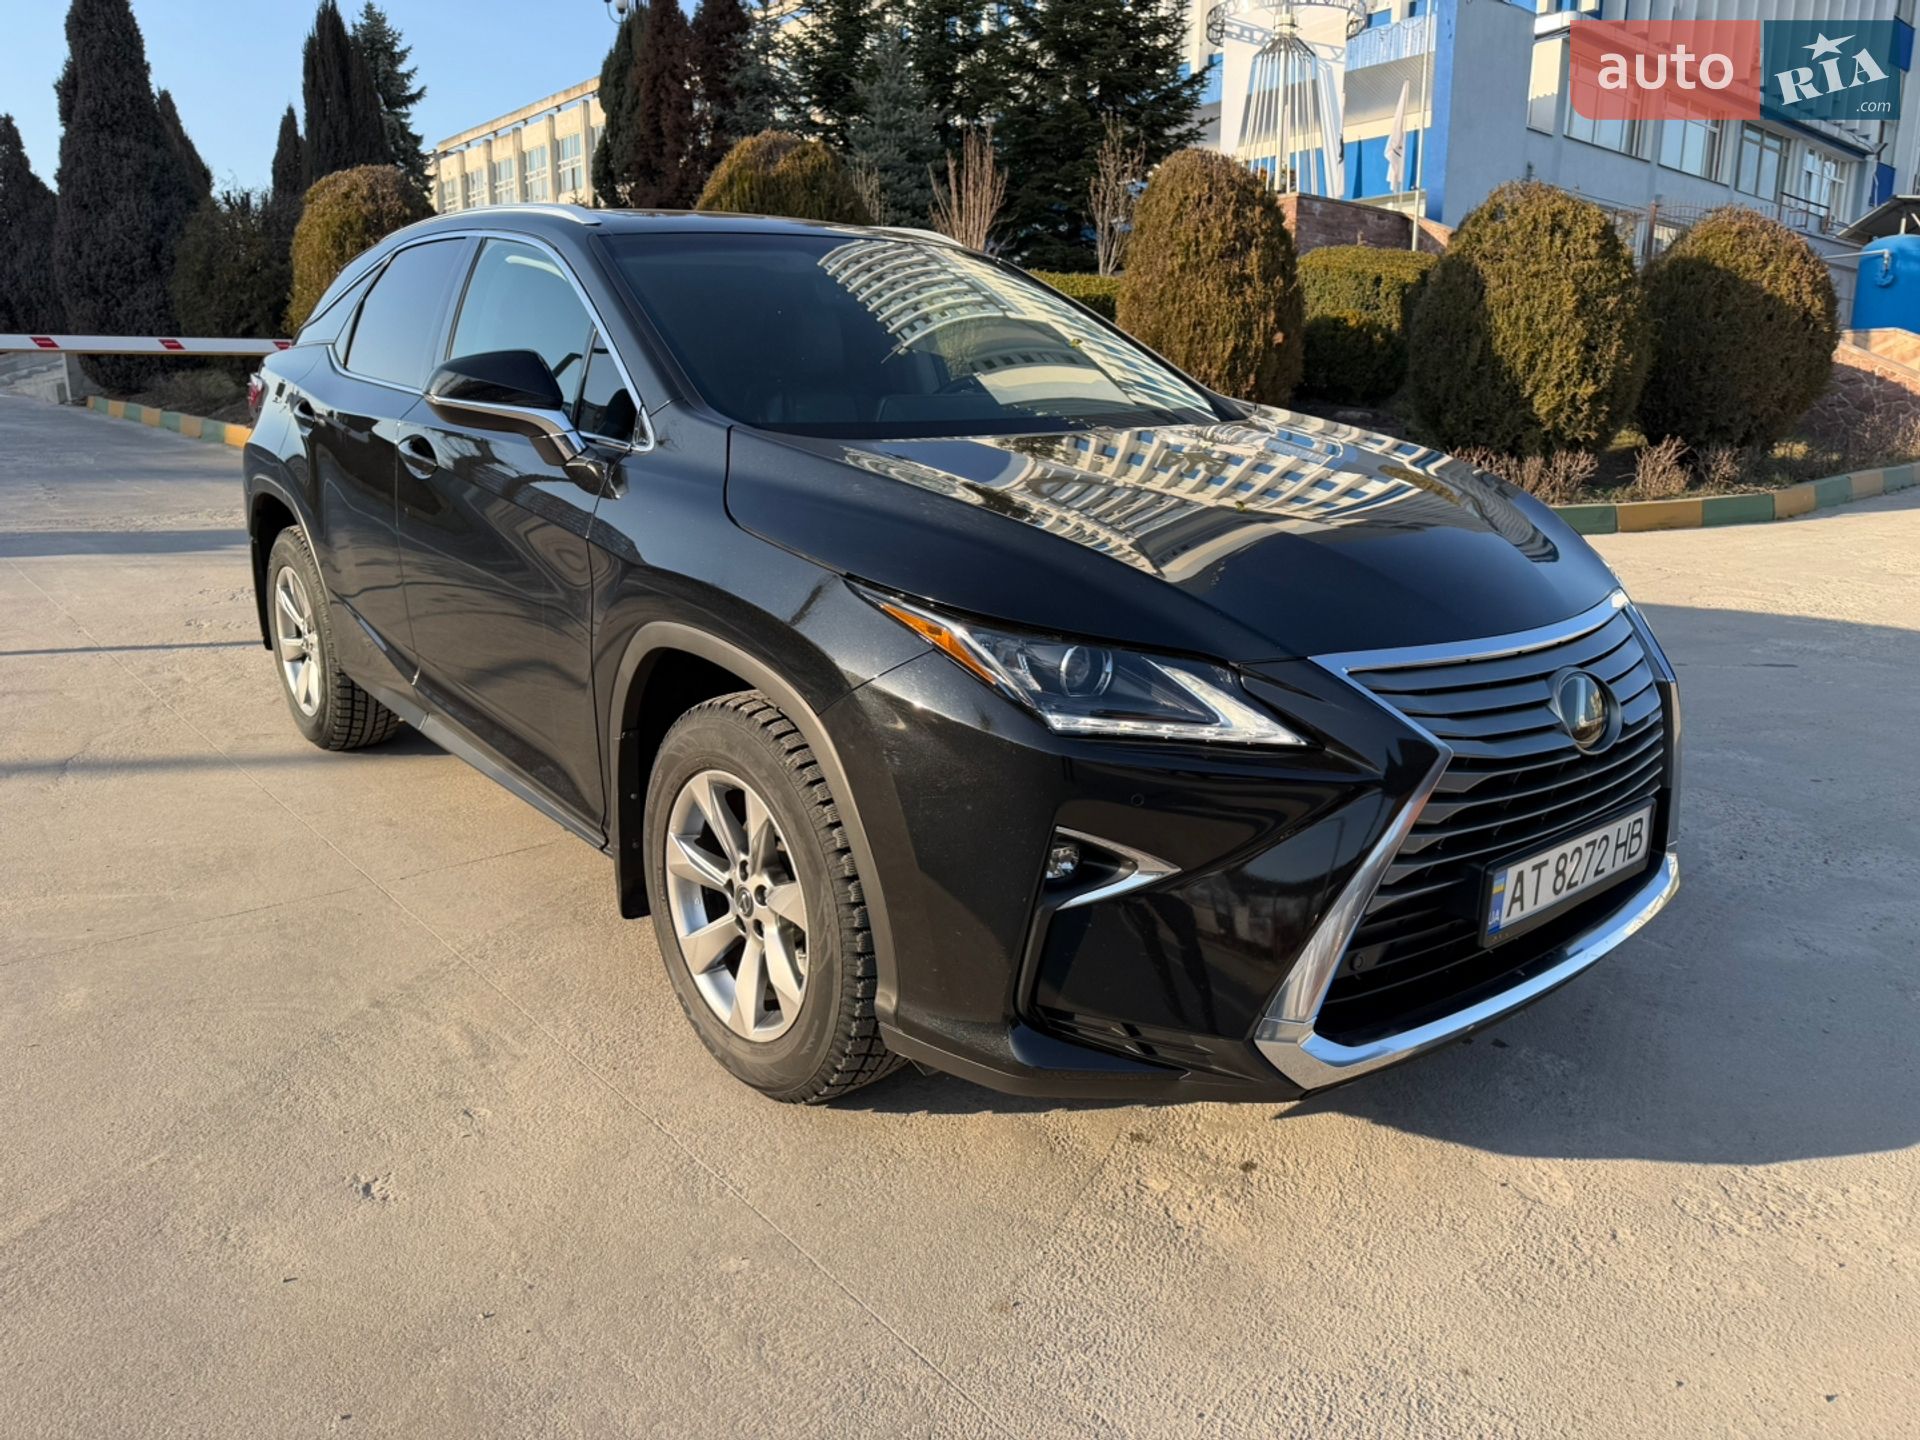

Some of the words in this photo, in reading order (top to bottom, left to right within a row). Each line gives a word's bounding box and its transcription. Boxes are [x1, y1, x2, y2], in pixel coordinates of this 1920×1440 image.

[1506, 859, 1549, 918] AT
[1552, 834, 1610, 896] 8272
[1612, 817, 1644, 868] HB
[1488, 909, 1500, 925] UA
